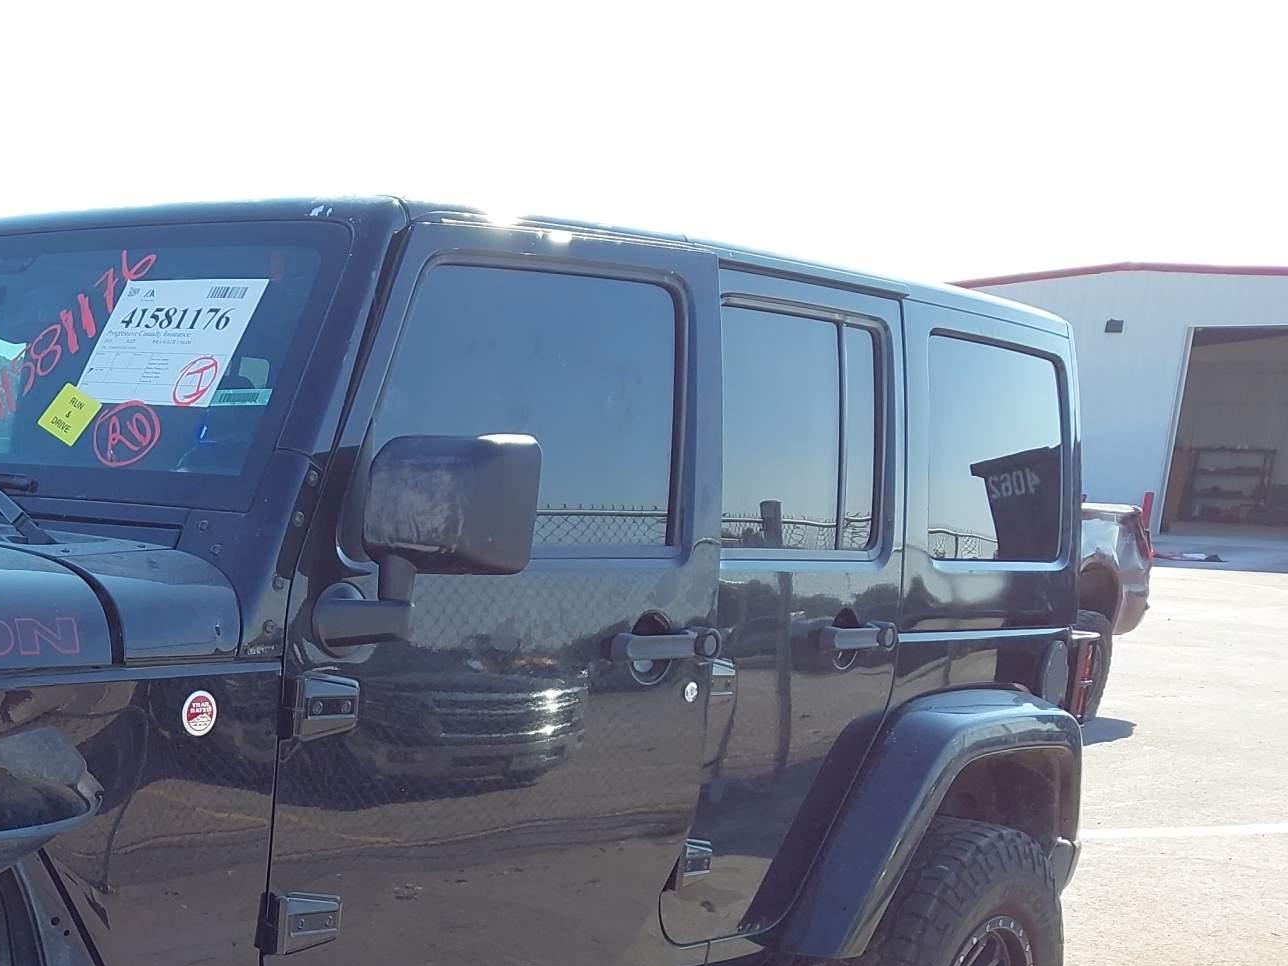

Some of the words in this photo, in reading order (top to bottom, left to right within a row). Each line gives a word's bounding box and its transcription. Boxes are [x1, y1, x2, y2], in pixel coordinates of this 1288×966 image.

[120, 307, 235, 330] 41581176
[70, 397, 84, 411] RUN
[51, 416, 72, 434] DRIVE
